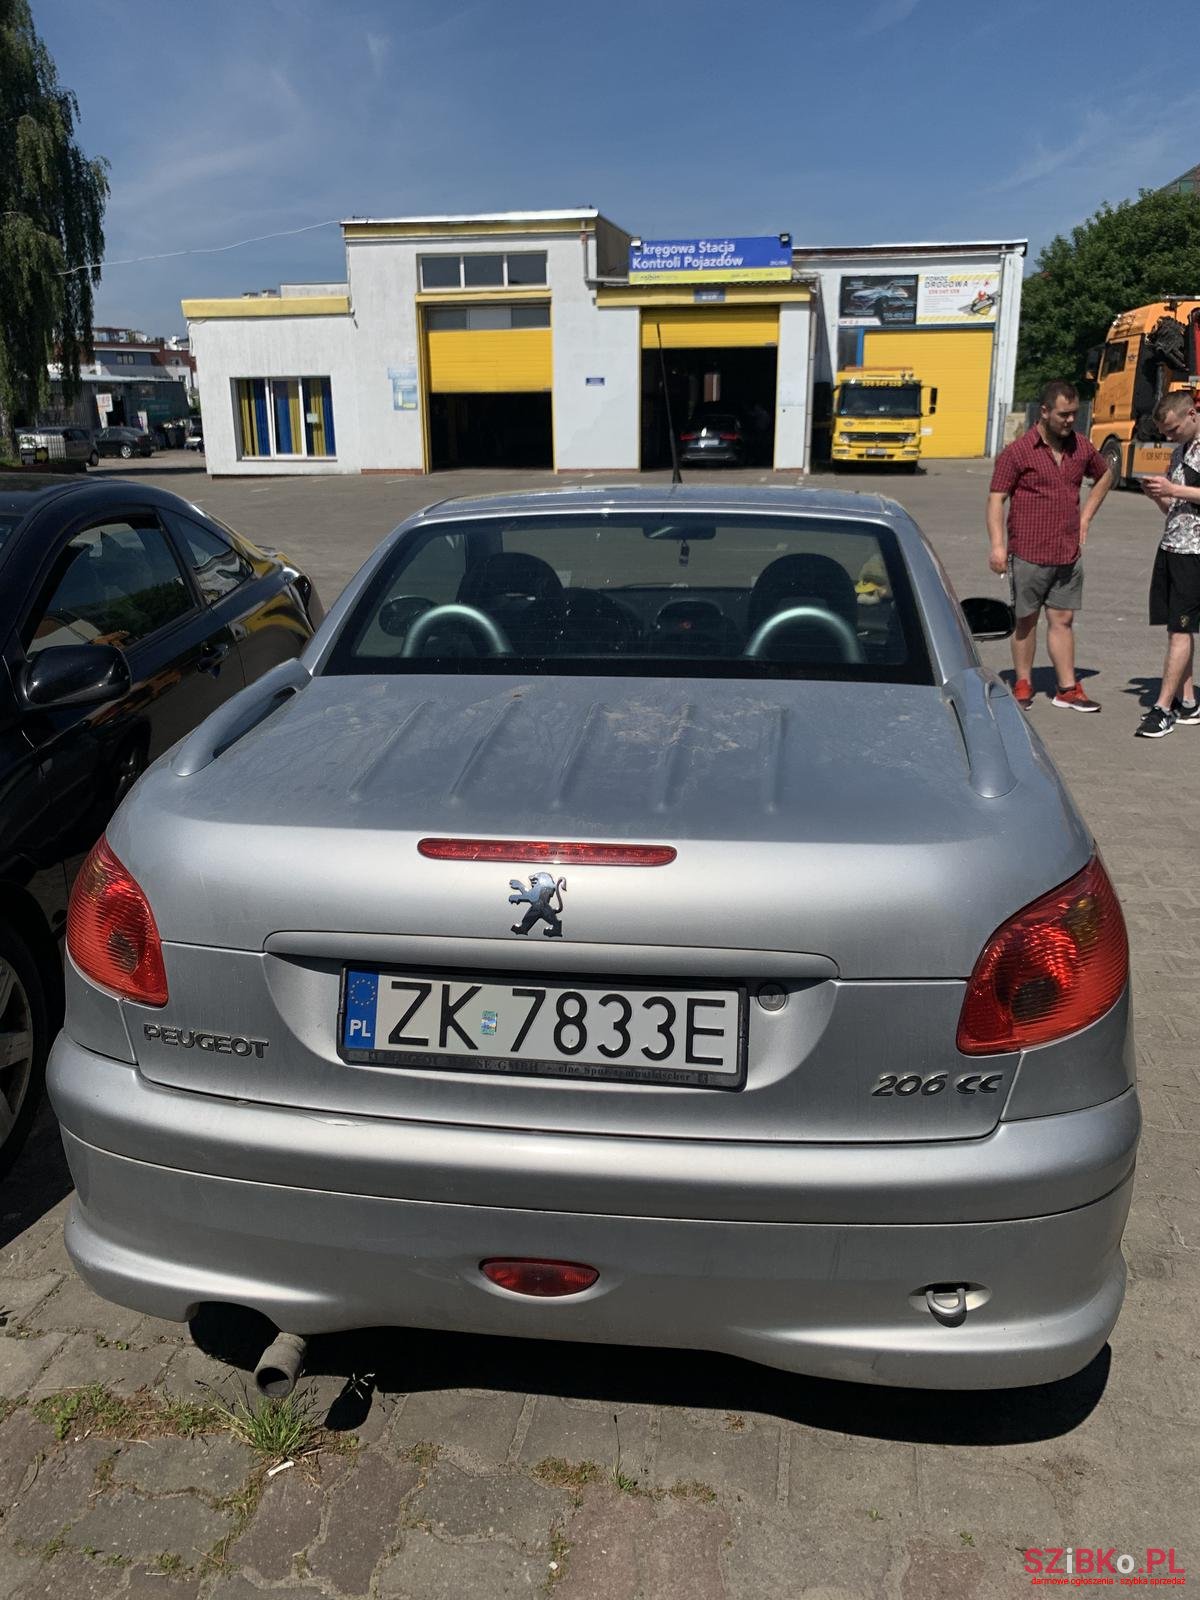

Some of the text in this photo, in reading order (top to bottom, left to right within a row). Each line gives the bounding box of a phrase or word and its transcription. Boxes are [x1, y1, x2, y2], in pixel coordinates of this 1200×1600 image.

[699, 241, 735, 259] Stacja
[632, 255, 744, 271] Kontroli Pojazdów
[924, 281, 969, 289] DROGOWA
[349, 1019, 371, 1037] PL
[388, 981, 726, 1066] ZK 7833E
[144, 1022, 269, 1058] PEUGEOT
[872, 1072, 1003, 1096] 206 CC
